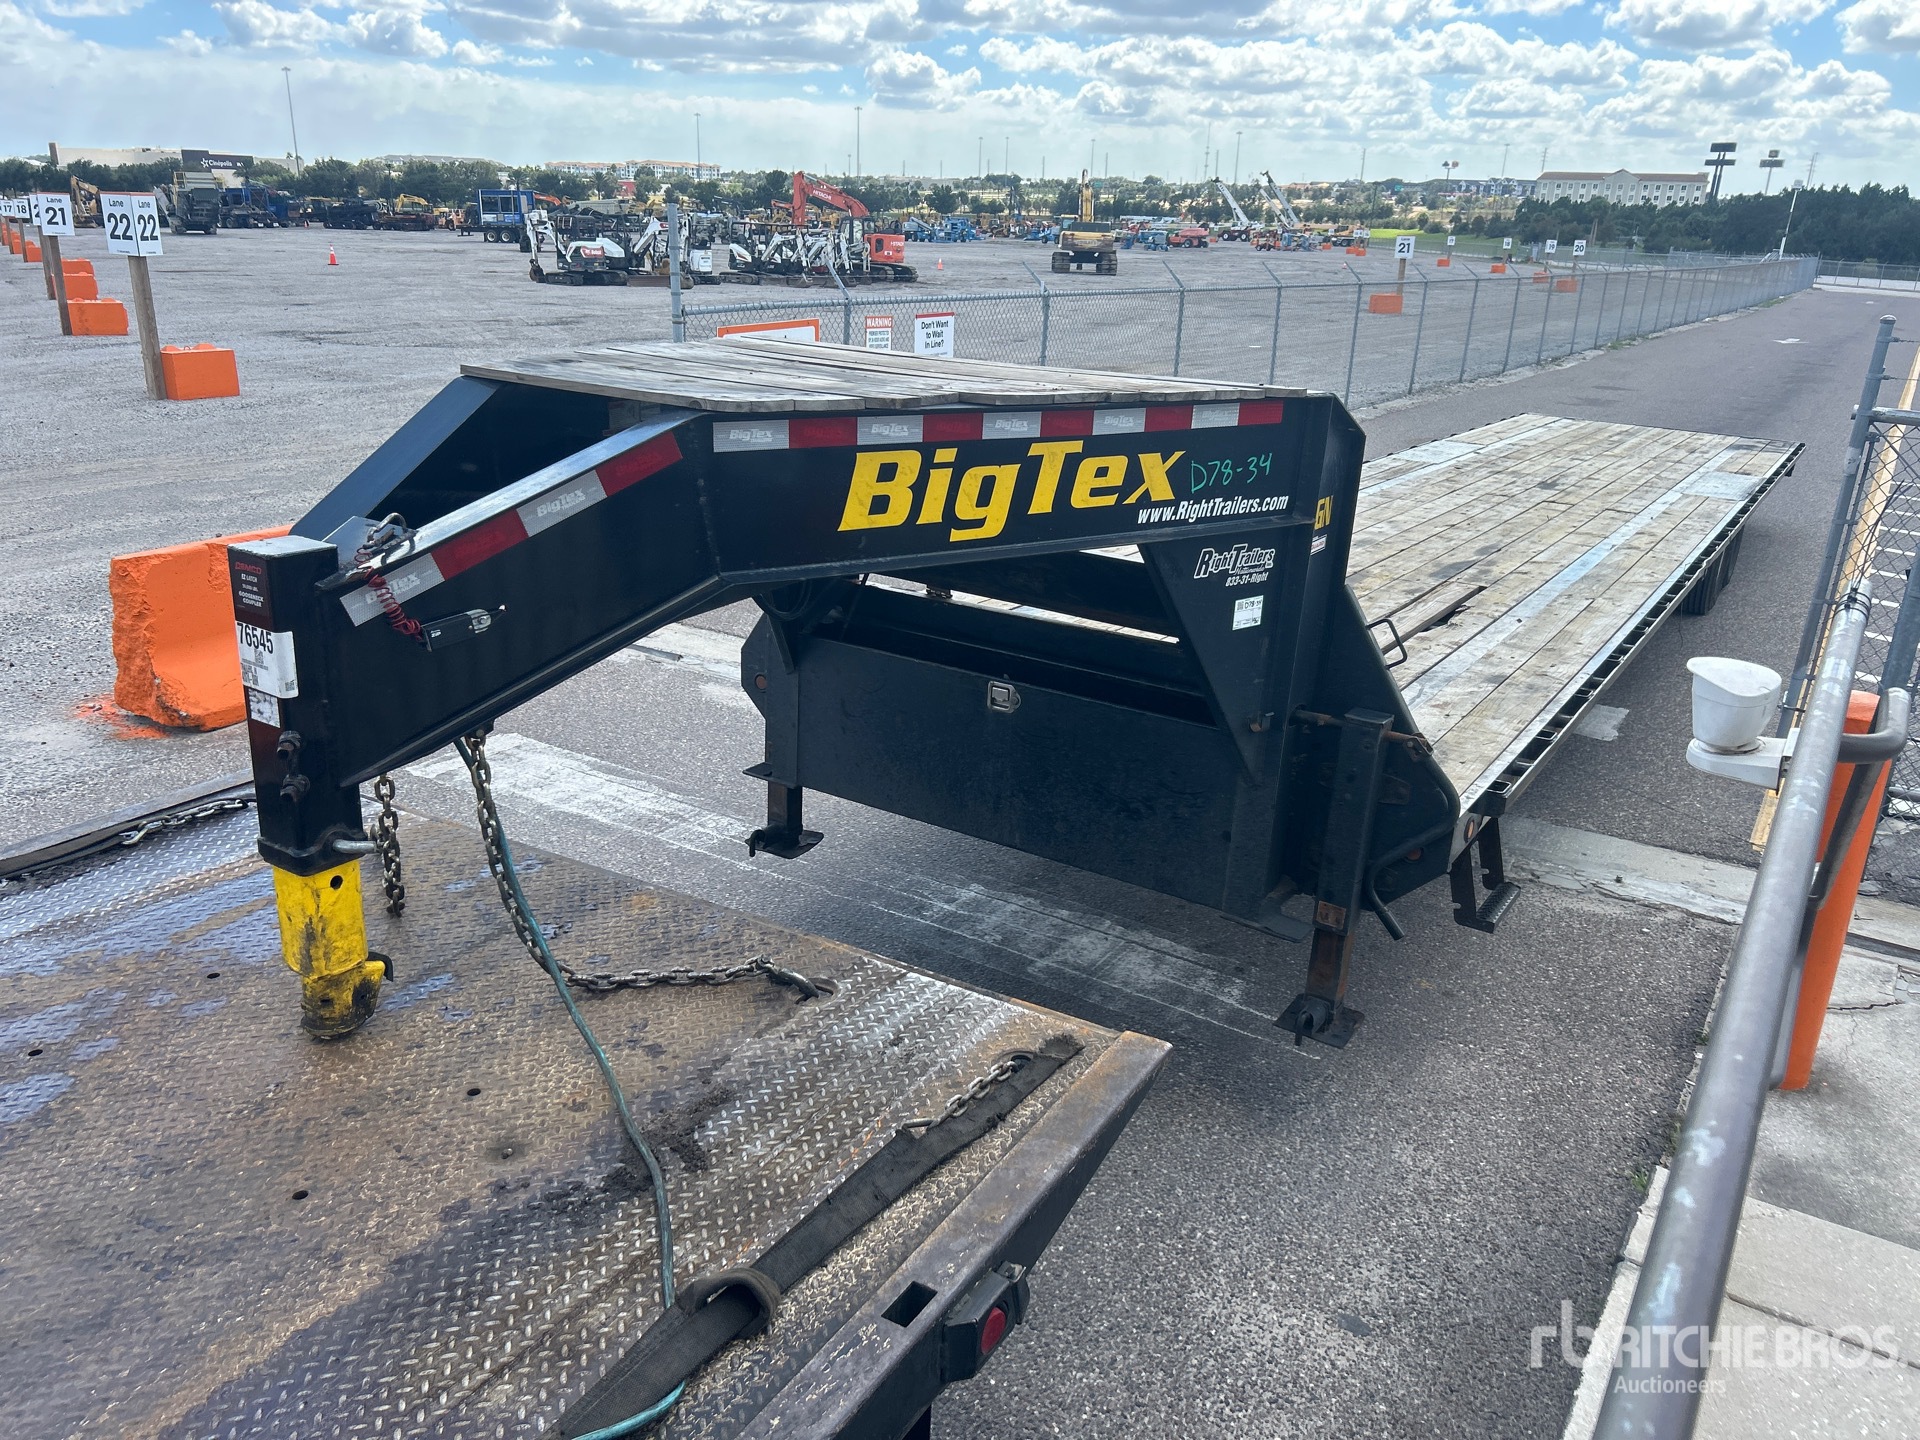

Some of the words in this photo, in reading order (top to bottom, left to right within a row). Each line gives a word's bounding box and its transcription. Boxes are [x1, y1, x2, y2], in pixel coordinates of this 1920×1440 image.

[46, 196, 63, 204] Lane
[813, 189, 832, 200] HITACHI
[108, 198, 124, 208] Lane
[137, 199, 151, 209] Lane
[16, 204, 27, 214] 18
[45, 206, 67, 226] 21
[107, 212, 134, 241] 22
[137, 213, 159, 242] 22
[1397, 242, 1411, 254] 21
[1574, 244, 1585, 253] 20
[866, 317, 892, 327] WARNING
[921, 321, 935, 330] Don't
[935, 320, 949, 328] Want
[925, 331, 932, 339] to
[932, 330, 944, 338] Wait
[924, 341, 931, 349] In
[930, 340, 944, 349] Line?
[871, 423, 910, 436] BigTex
[995, 419, 1029, 430] BigTex
[729, 428, 773, 442] BigTex
[1191, 453, 1273, 494] D78-34
[836, 440, 1186, 542] BigTex
[1137, 495, 1289, 524] www.RightTrailers.com
[365, 572, 419, 604] BTex
[236, 621, 274, 654] 76545
